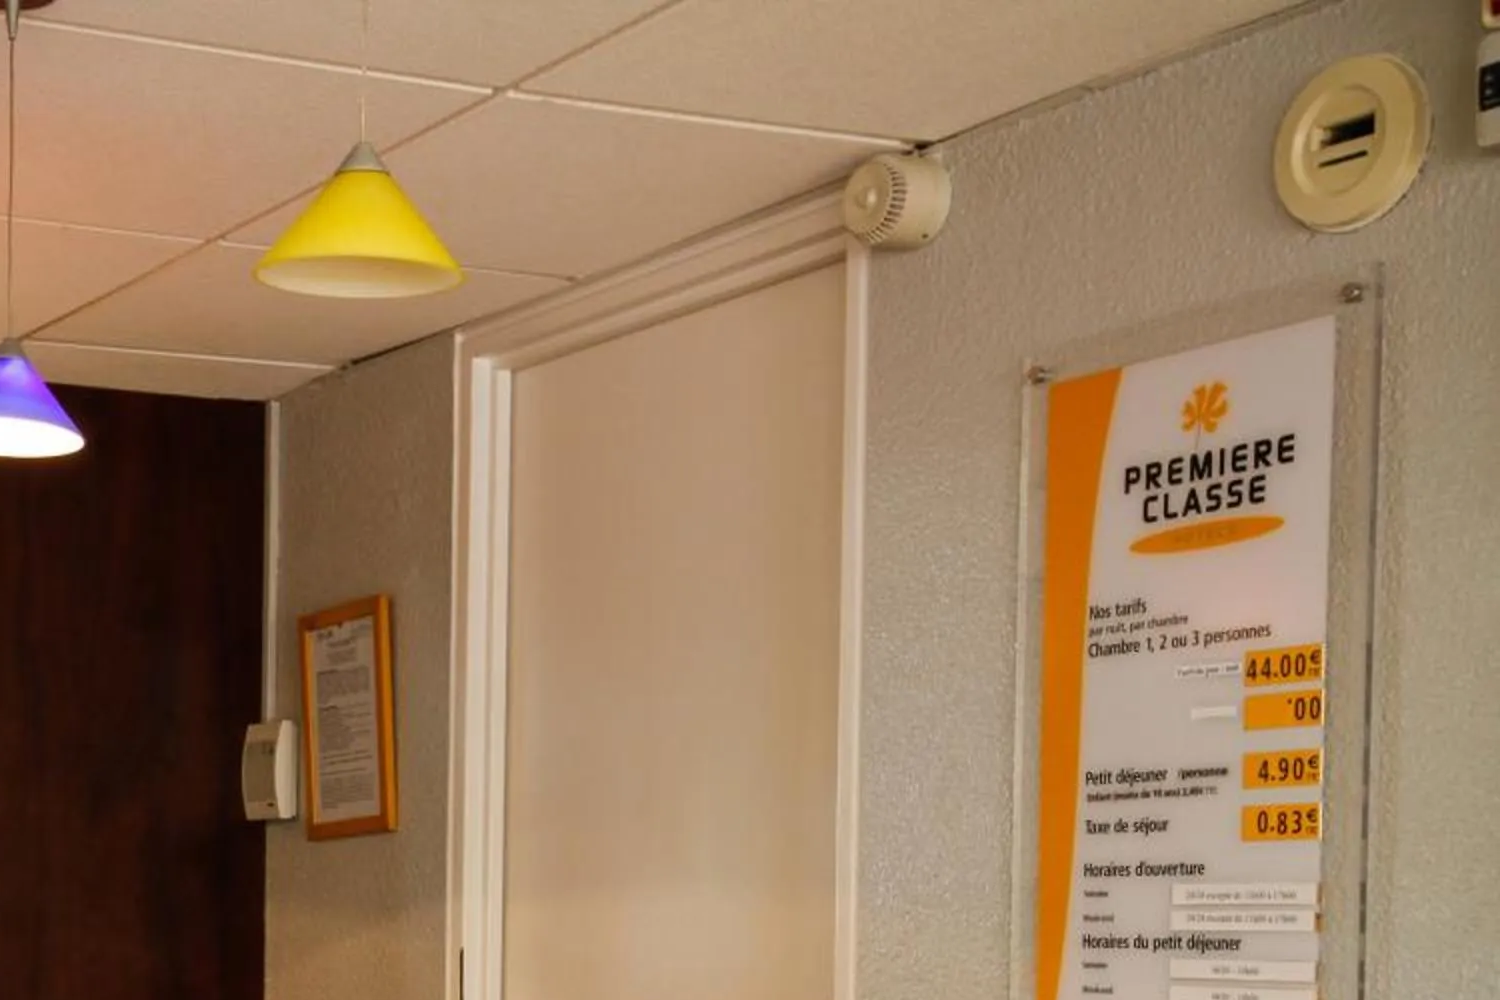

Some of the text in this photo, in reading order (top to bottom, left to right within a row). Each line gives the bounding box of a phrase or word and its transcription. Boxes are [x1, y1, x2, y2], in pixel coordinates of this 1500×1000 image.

[1124, 433, 1296, 495] PREMIERE
[1143, 474, 1267, 524] CLASSE
[1089, 599, 1148, 620] Nos tarifs
[1130, 620, 1146, 633] par
[1148, 614, 1189, 630] chambre
[1088, 624, 1272, 659] Chambre 1, 2 ou 3 personnes
[1086, 770, 1112, 785] Petit
[1116, 768, 1168, 787] déjeuner
[1085, 816, 1169, 836] Taxe de séjour
[1083, 860, 1206, 877] Horaires d'ouverture
[1082, 932, 1242, 954] Horaires du petit déjeuner
